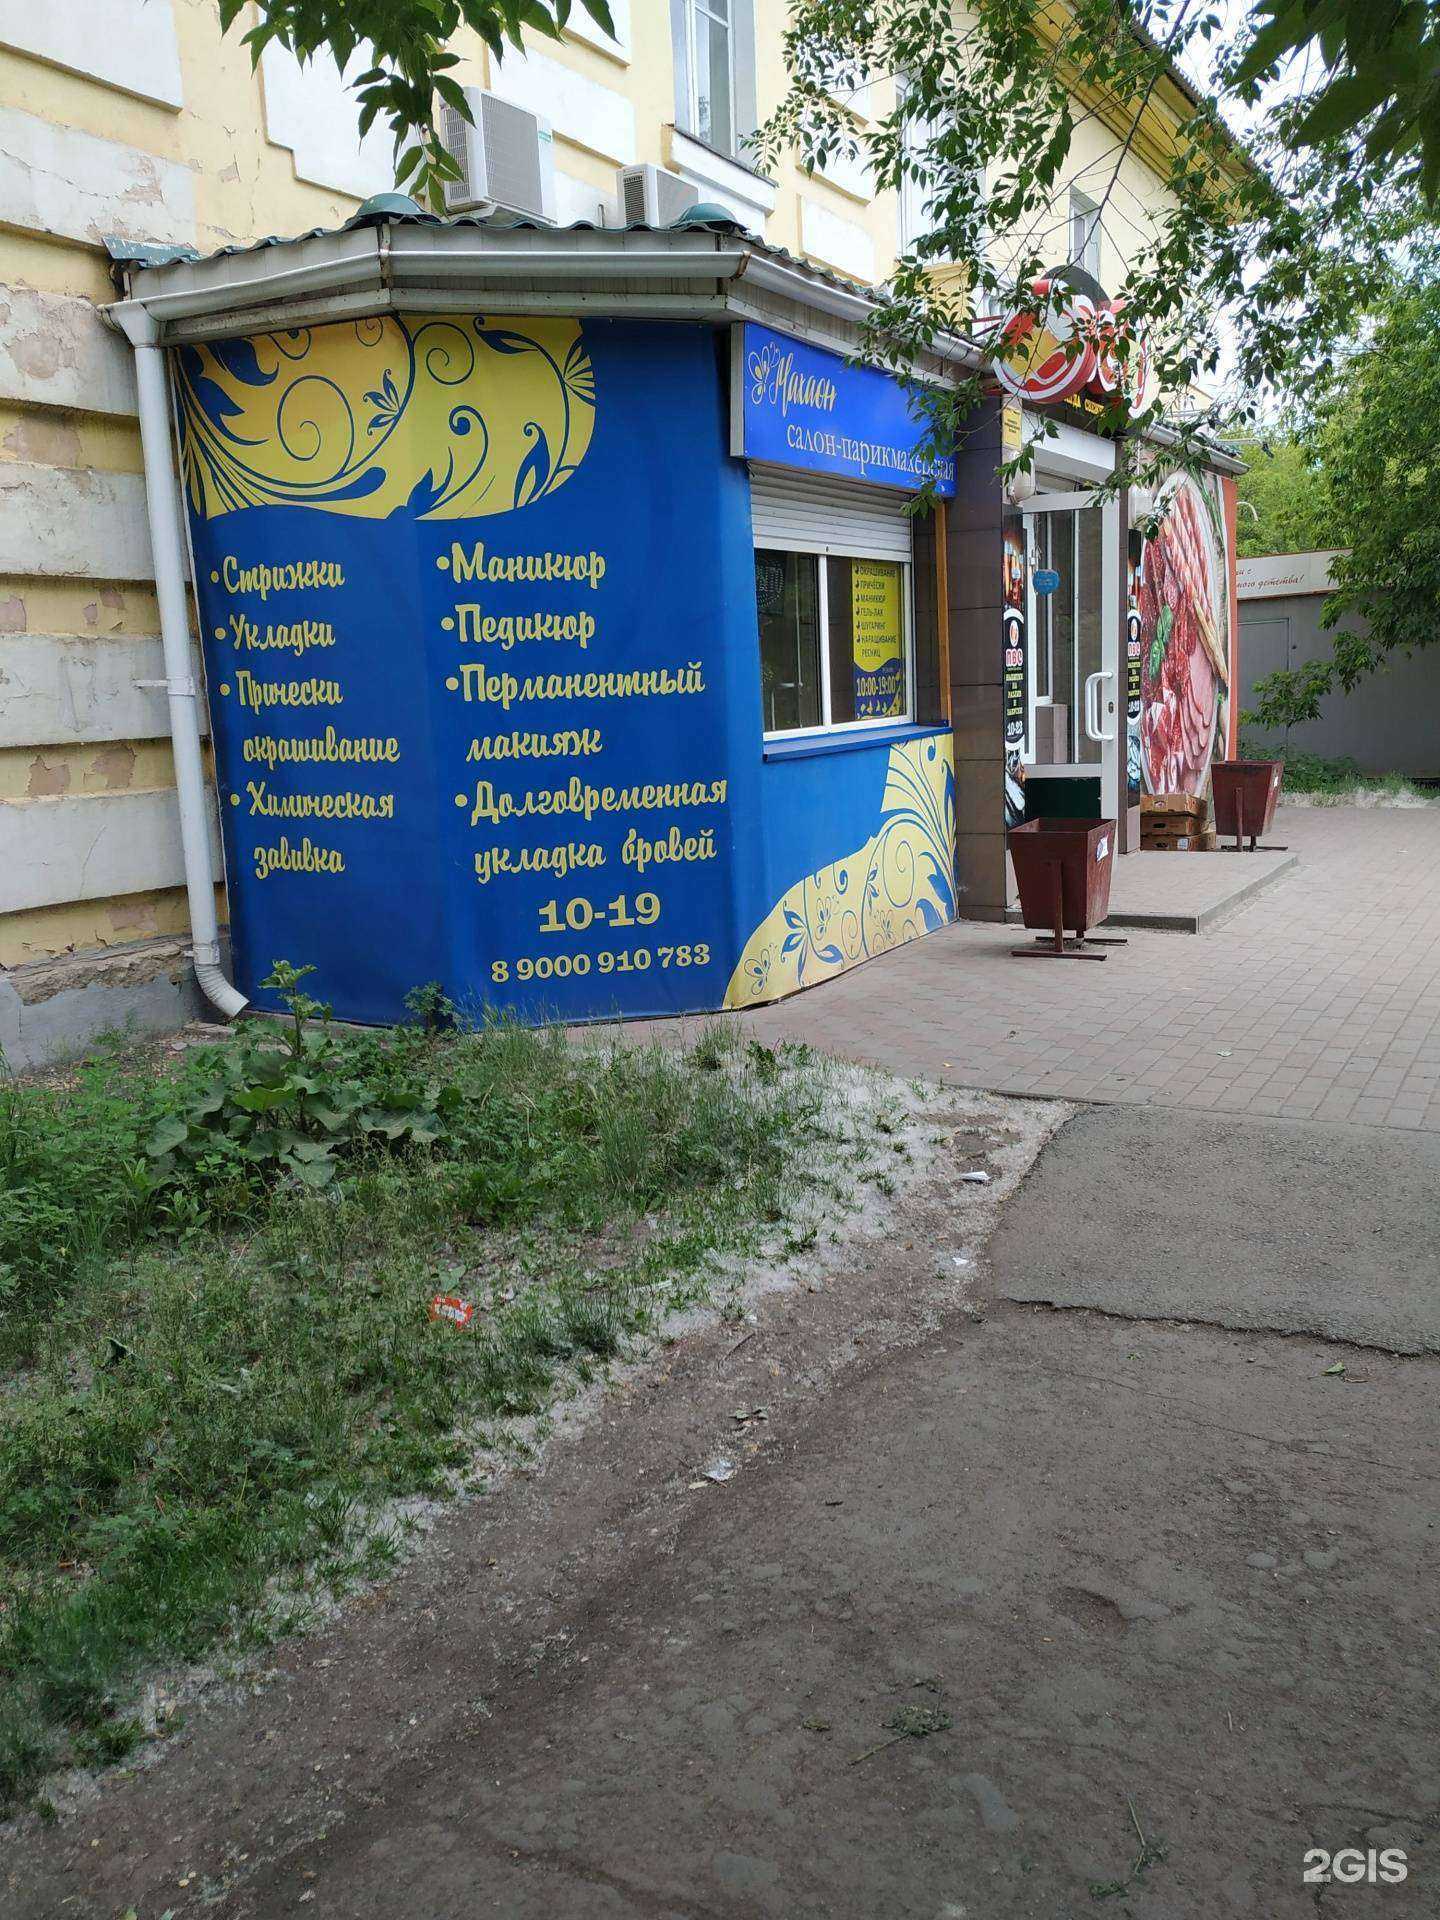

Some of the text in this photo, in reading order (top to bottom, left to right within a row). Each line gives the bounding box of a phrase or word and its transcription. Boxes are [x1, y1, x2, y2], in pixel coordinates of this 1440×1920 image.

[773, 352, 837, 417] Махаон
[222, 555, 346, 601] Стрижки
[451, 541, 606, 590] Маникюр
[229, 613, 336, 657] Укладки
[454, 603, 595, 651] Педикюр
[235, 670, 344, 715] Прически
[459, 661, 706, 711] Перманентный
[243, 725, 401, 771] окрашивание
[465, 728, 603, 763] макияж
[246, 781, 395, 819] Химическая
[470, 776, 728, 827] Долговременная
[253, 836, 346, 880] завивка
[474, 826, 718, 884] укладка бровей
[538, 892, 661, 933] 10-19
[491, 943, 711, 983] 8 9000 910 783
